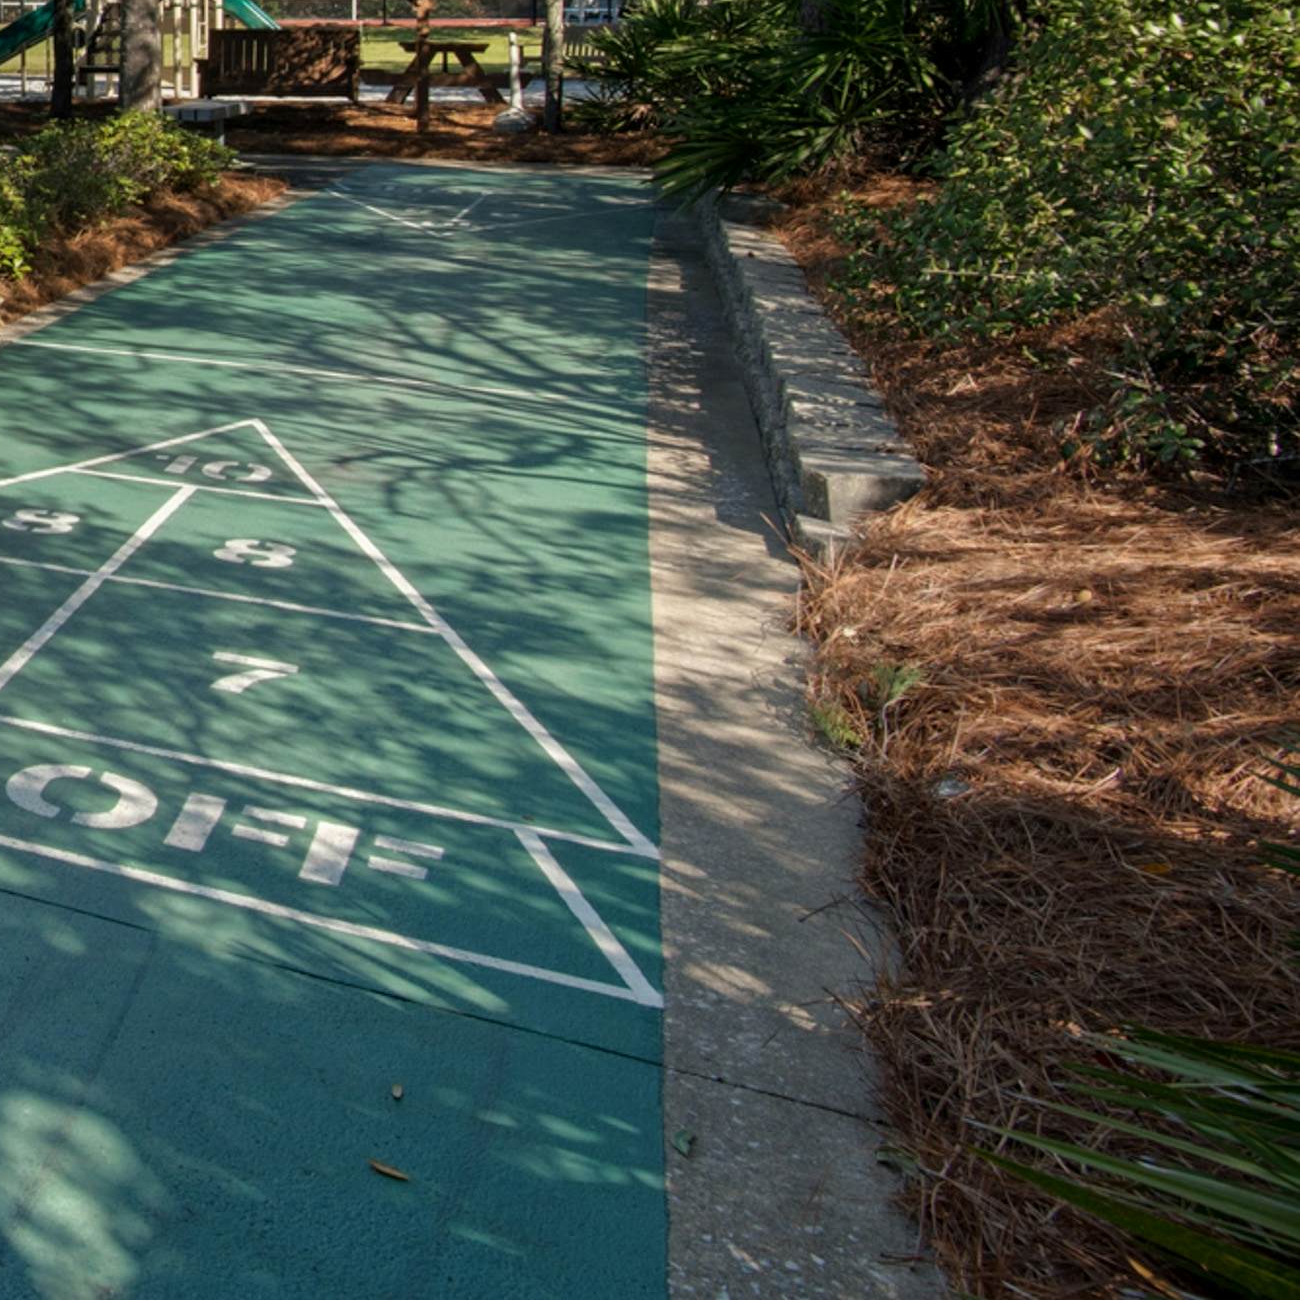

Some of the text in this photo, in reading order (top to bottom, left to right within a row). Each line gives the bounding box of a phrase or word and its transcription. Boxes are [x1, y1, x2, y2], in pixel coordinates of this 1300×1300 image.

[155, 454, 272, 482] 10
[2, 509, 80, 534] 8
[213, 538, 297, 568] 8
[210, 651, 299, 694] 7
[5, 764, 445, 887] OFF
